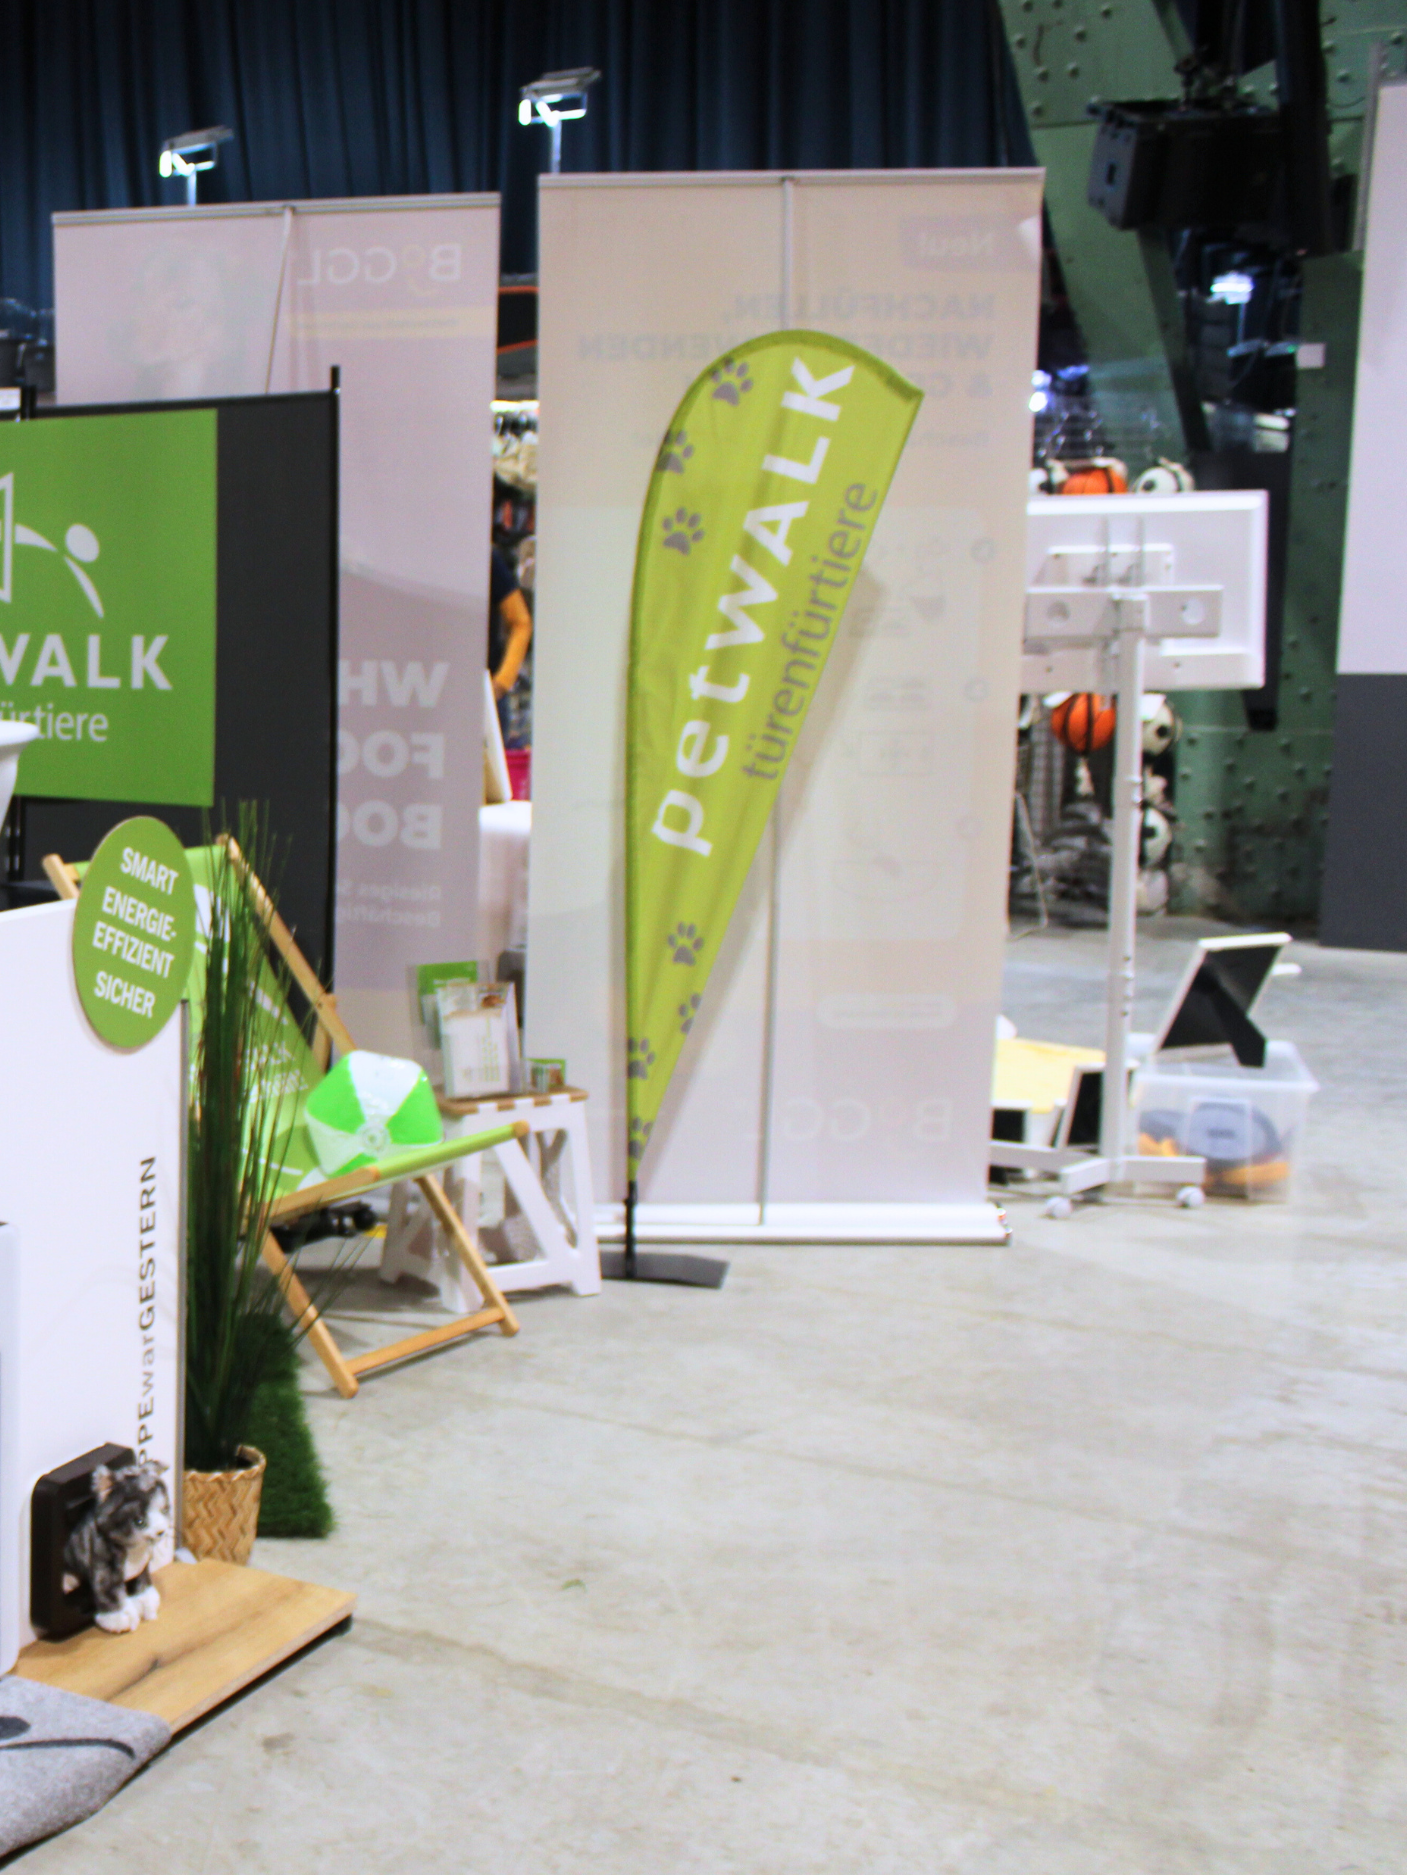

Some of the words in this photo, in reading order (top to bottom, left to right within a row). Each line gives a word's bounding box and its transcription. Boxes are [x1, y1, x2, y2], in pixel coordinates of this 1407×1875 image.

[651, 356, 855, 857] petWALK
[741, 482, 878, 780] türenfürtiere
[120, 847, 179, 895] SMART
[101, 886, 177, 941] ENERGIE-
[92, 920, 175, 978] EFFIZIENT
[94, 970, 156, 1018] SICHER
